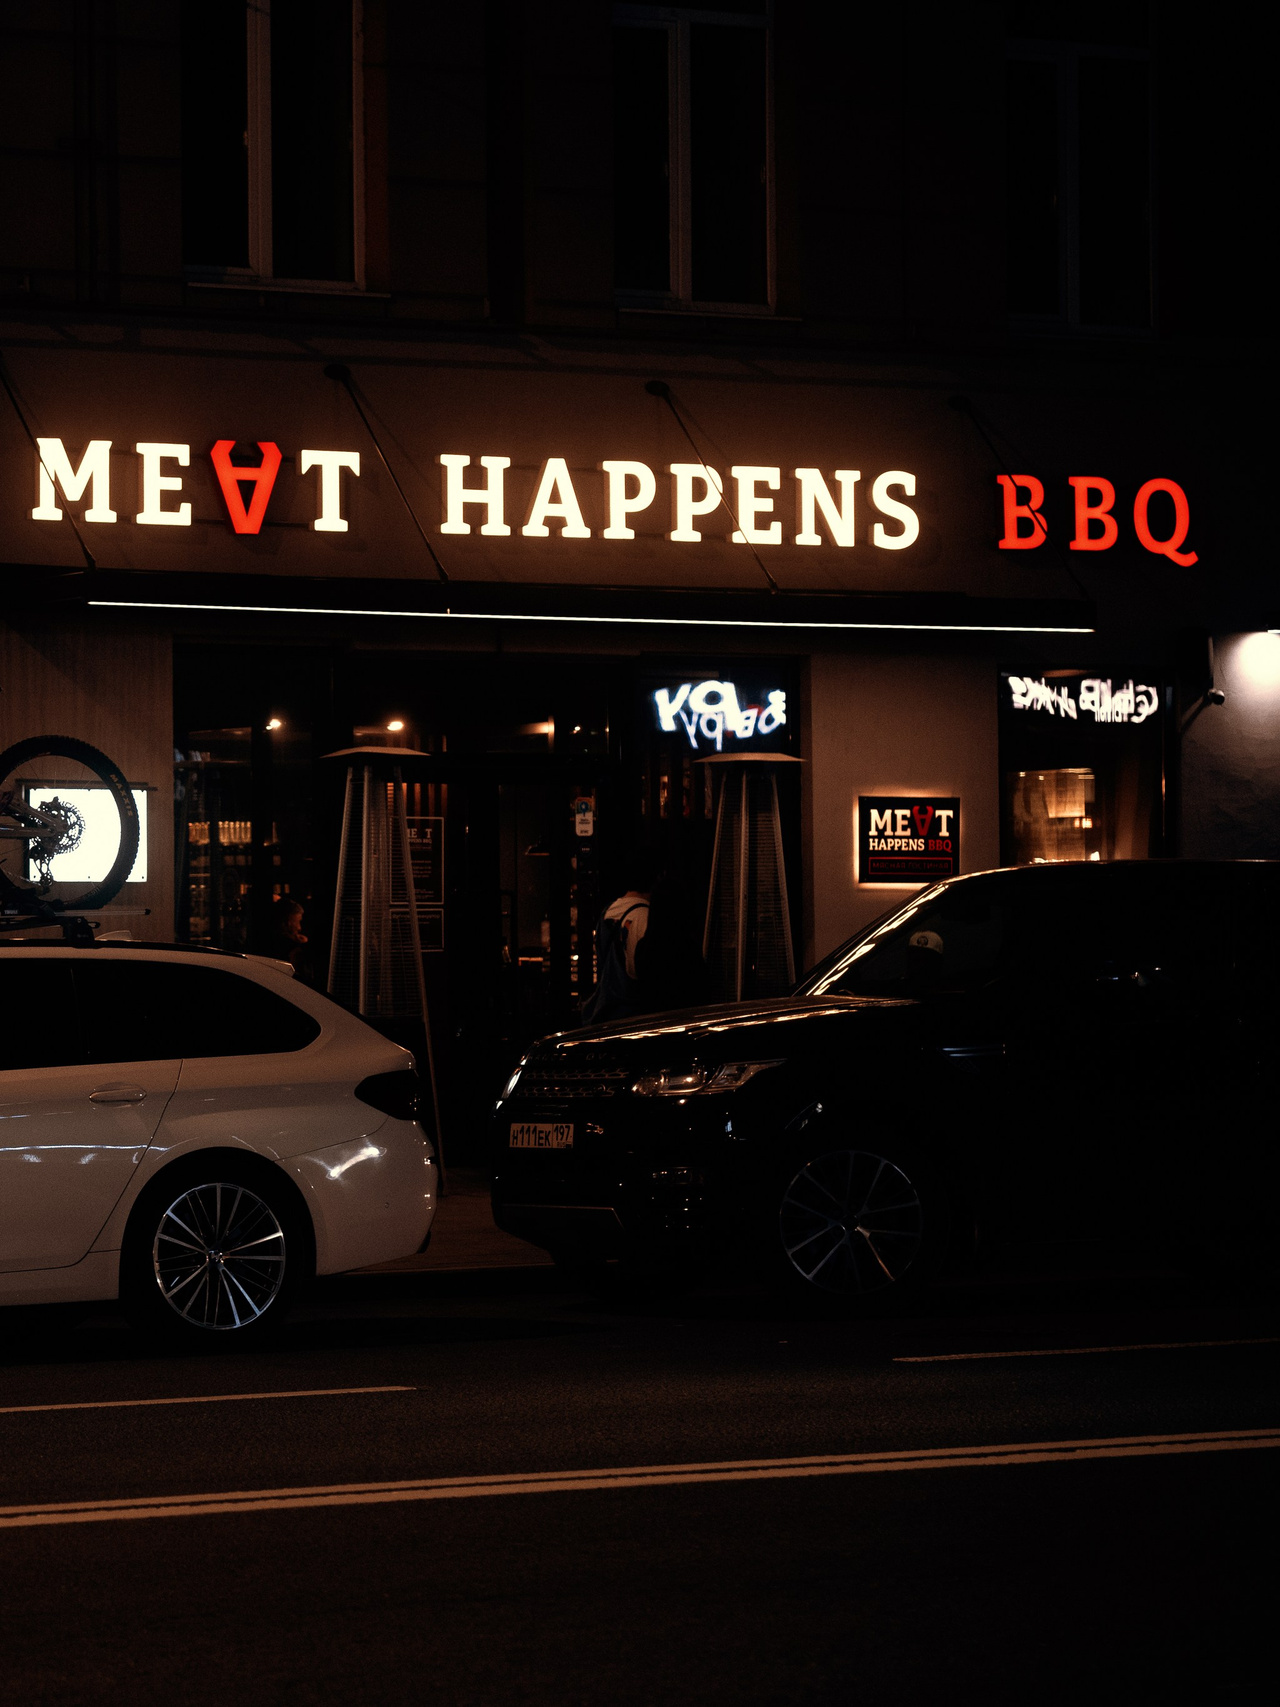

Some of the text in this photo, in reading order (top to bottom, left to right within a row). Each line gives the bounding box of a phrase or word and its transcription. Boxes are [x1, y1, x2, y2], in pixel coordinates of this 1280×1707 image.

[32, 437, 1199, 568] MEAT HAPPENS BBQ
[869, 805, 953, 837] MEAT
[869, 838, 952, 853] HAPPENS BBQ
[554, 1125, 570, 1141] 197
